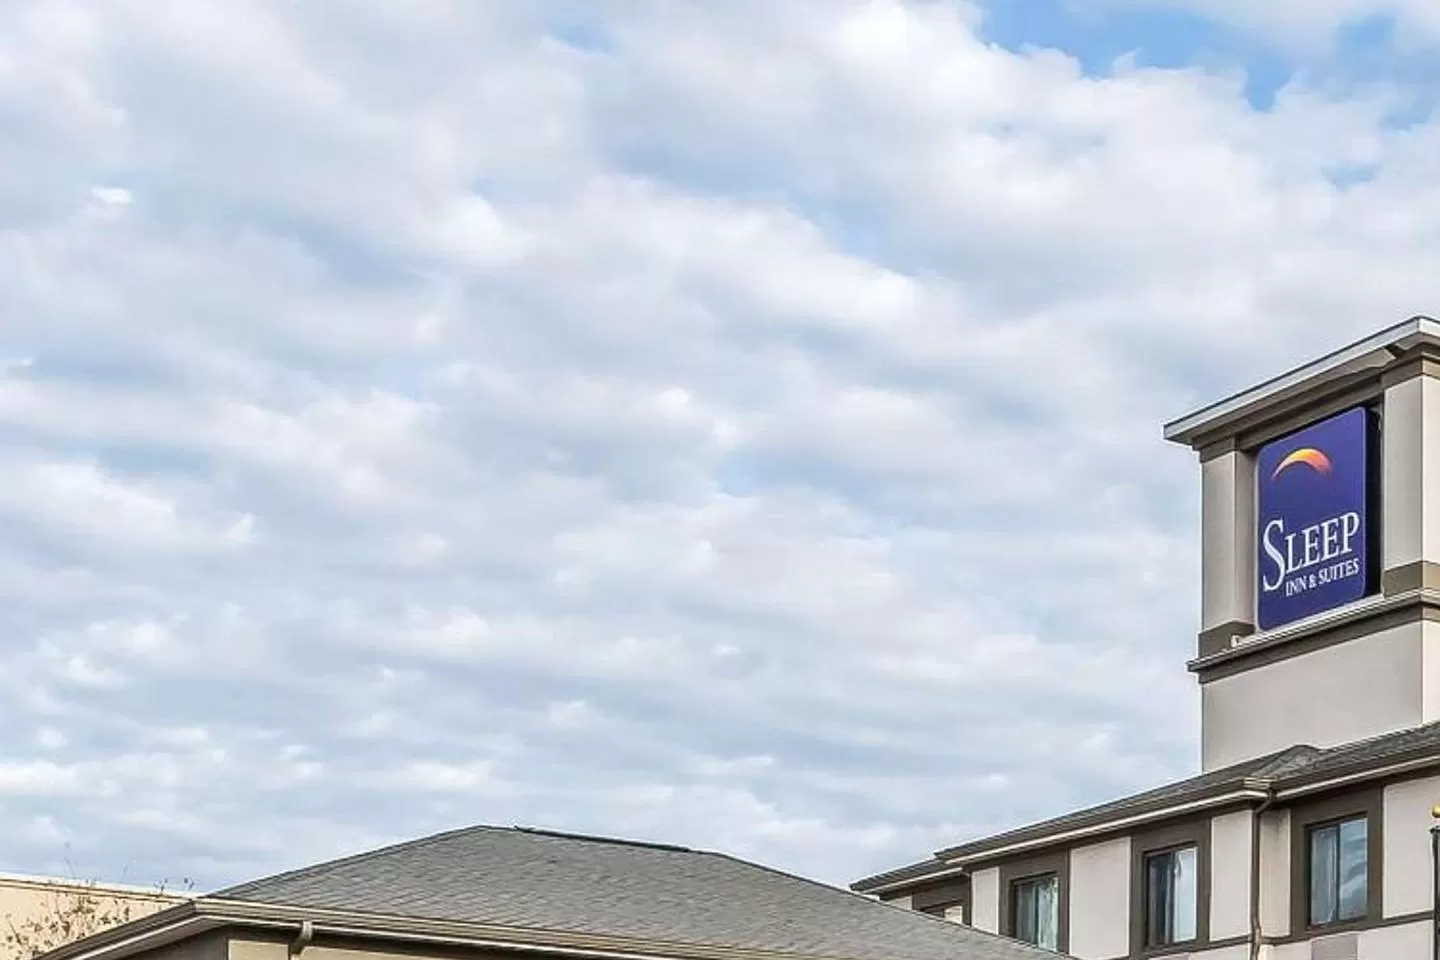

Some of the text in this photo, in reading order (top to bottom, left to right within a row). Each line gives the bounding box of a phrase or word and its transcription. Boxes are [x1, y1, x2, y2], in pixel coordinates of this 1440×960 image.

[1263, 512, 1359, 592] SLEEP
[1286, 558, 1359, 596] INN & SUITES
